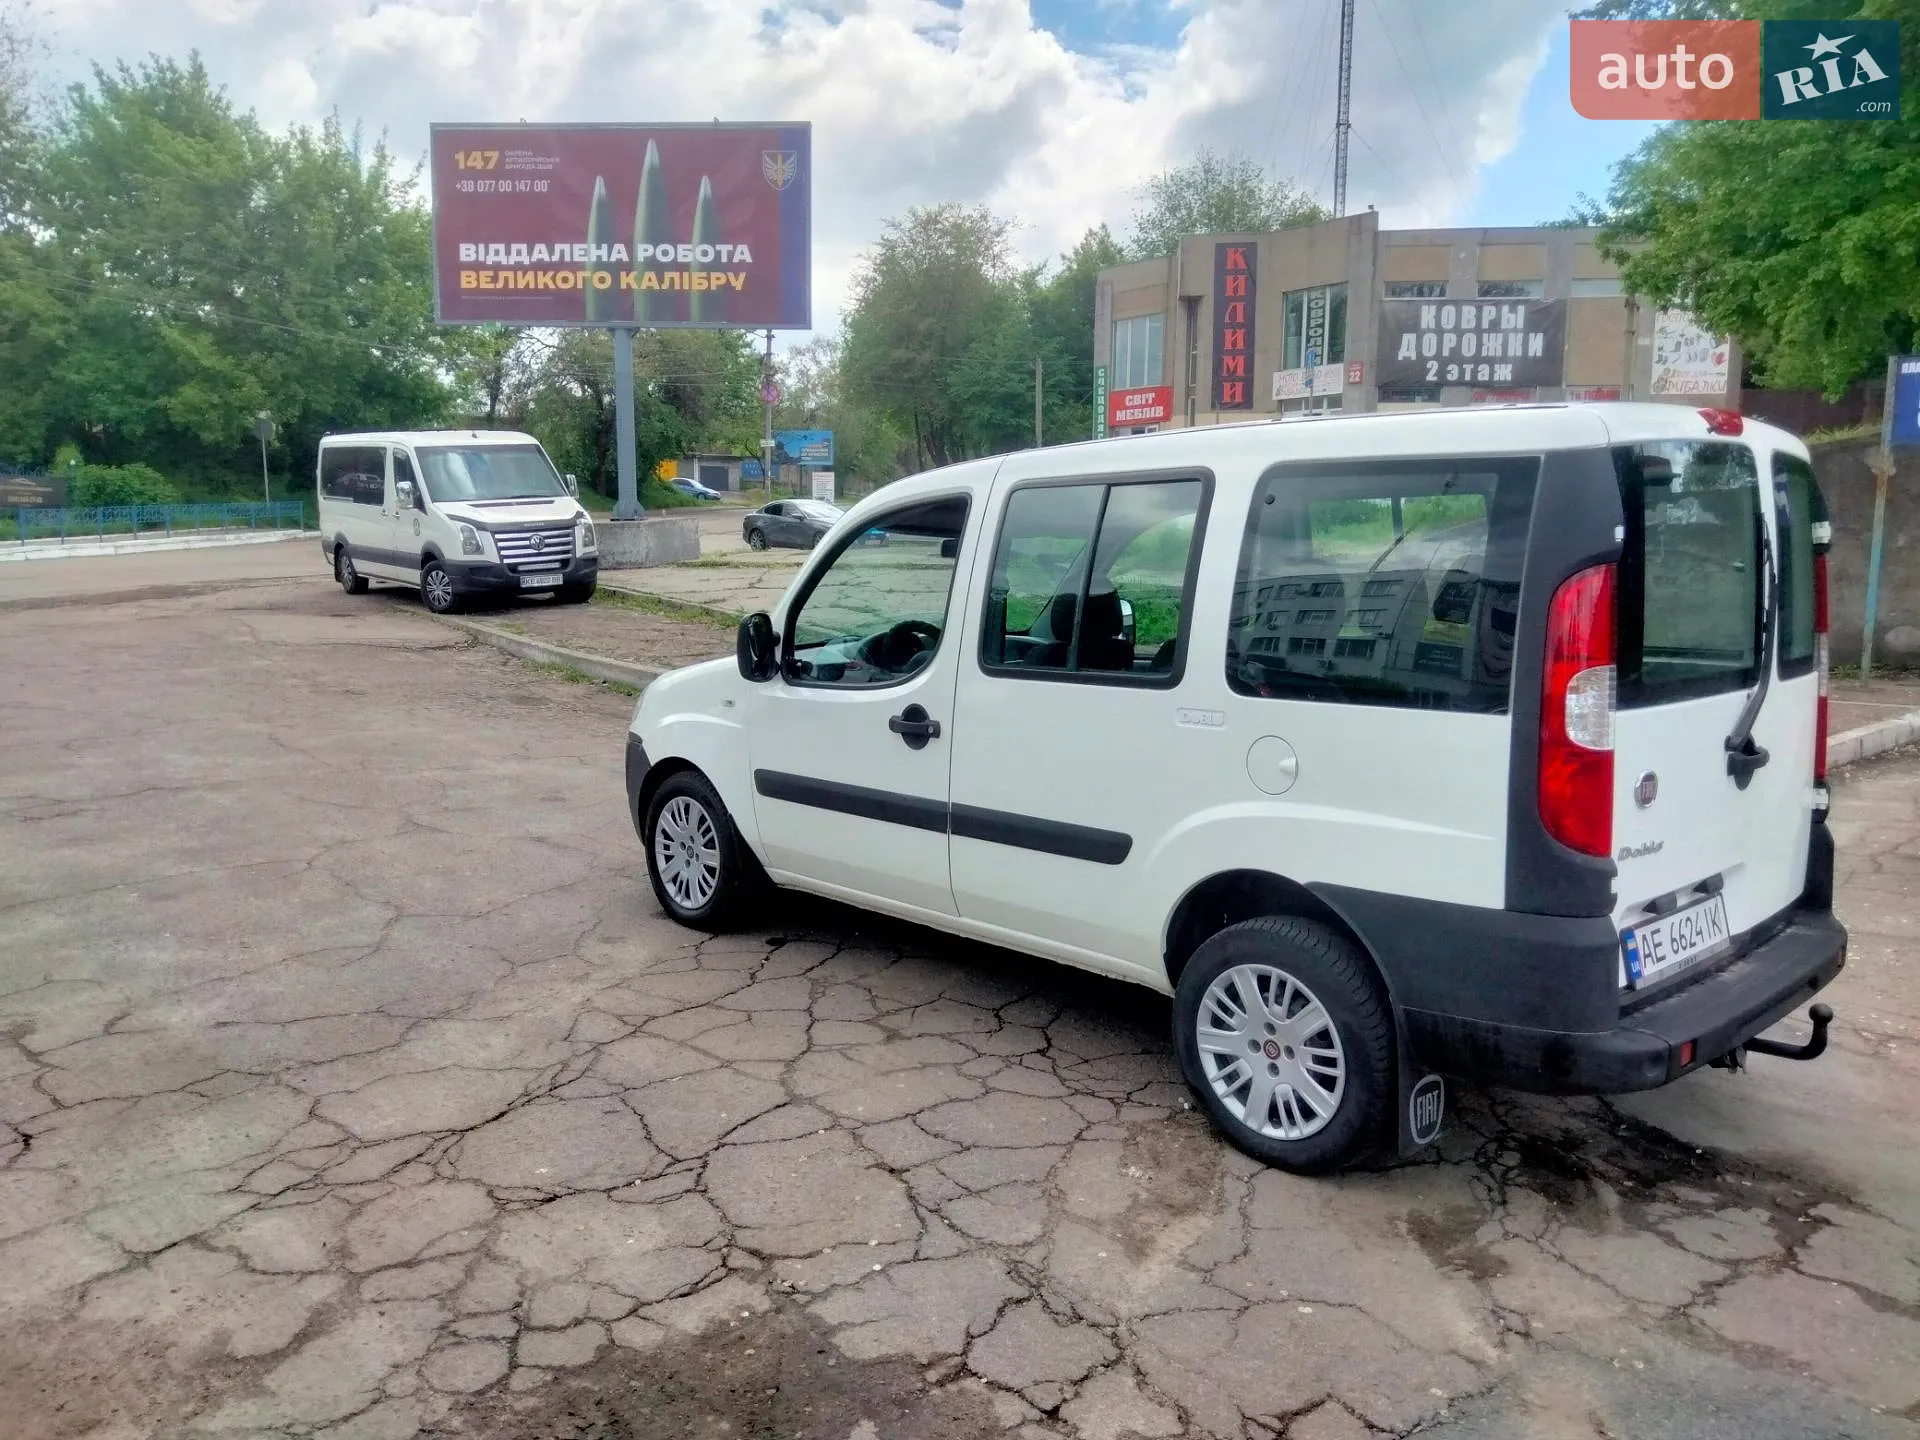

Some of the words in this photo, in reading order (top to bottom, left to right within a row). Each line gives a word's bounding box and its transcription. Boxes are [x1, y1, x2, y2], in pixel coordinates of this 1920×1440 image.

[454, 151, 499, 170] 147
[456, 180, 474, 192] +38
[477, 180, 496, 192] 077
[498, 180, 512, 192] 00
[515, 180, 530, 192] 147
[459, 243, 629, 265] ВІДДАЛЕНА
[636, 244, 752, 263] РОБОТА
[460, 271, 612, 290] ВЕЛИКОГО
[620, 271, 746, 291] КАЛІБРУ
[1222, 247, 1248, 404] КИЛИМИ
[1421, 305, 1525, 329] КОВРЫ
[1398, 332, 1544, 360] ДОРОЖКИ
[1348, 370, 1361, 383] 22
[1426, 360, 1438, 381] 2
[1446, 363, 1513, 381] этаж
[1125, 393, 1155, 406] СВІТ
[1116, 406, 1164, 421] МЕБЛІВ
[1641, 927, 1666, 968] AE
[1670, 911, 1705, 955] 6624
[1704, 902, 1722, 940] IK
[1417, 1090, 1439, 1129] FIAT
